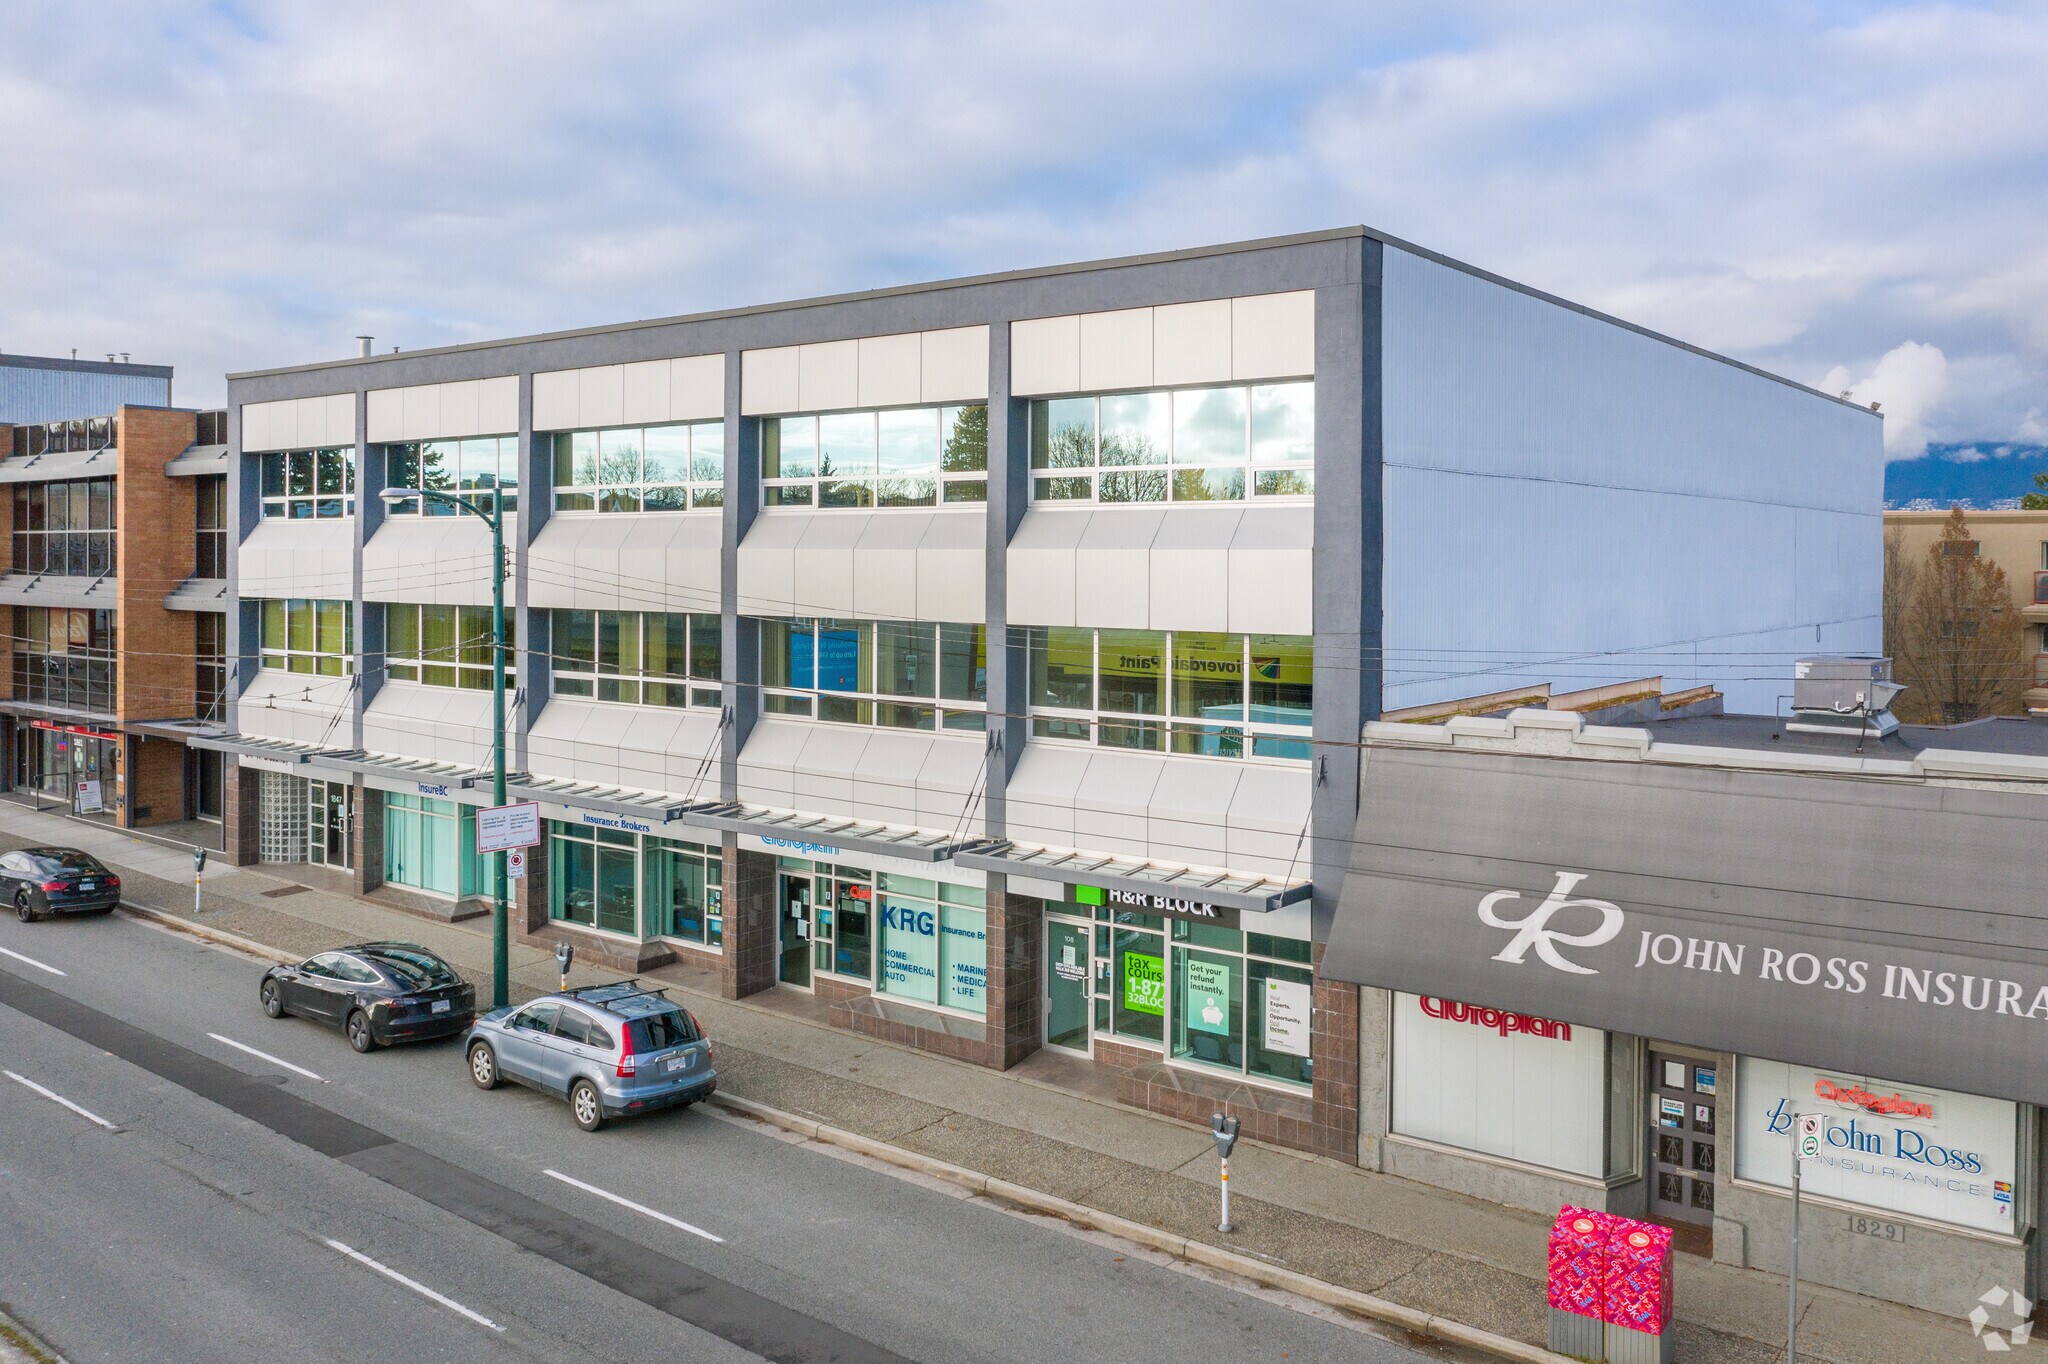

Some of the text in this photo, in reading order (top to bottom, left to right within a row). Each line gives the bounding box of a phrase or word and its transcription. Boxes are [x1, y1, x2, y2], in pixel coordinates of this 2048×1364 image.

[418, 782, 448, 796] InsureBC
[331, 794, 342, 803] 1847
[584, 814, 650, 832] Insurance Brokers
[1109, 889, 1216, 918] H&R BLOCK
[882, 904, 935, 937] KRG
[941, 924, 976, 939] Insurance
[884, 948, 907, 961] HOME
[884, 959, 935, 978] COMMERCIAL
[1128, 955, 1150, 970] tax
[1190, 963, 1222, 977] Get your
[884, 971, 906, 982] AUTO
[1190, 973, 1215, 984] refund
[1635, 931, 2048, 1020] JOHN ROSS INSURA
[957, 987, 975, 998] LIFE
[1190, 982, 1224, 996] instantly.
[1270, 1013, 1302, 1025] Opportunity.
[1824, 1116, 1982, 1174] ohn Ross
[1809, 1154, 1982, 1196] NSURANCE
[1847, 1216, 1896, 1239] 1829
[1565, 1284, 1582, 1303] T9K
[1622, 1299, 1639, 1319] T9K
